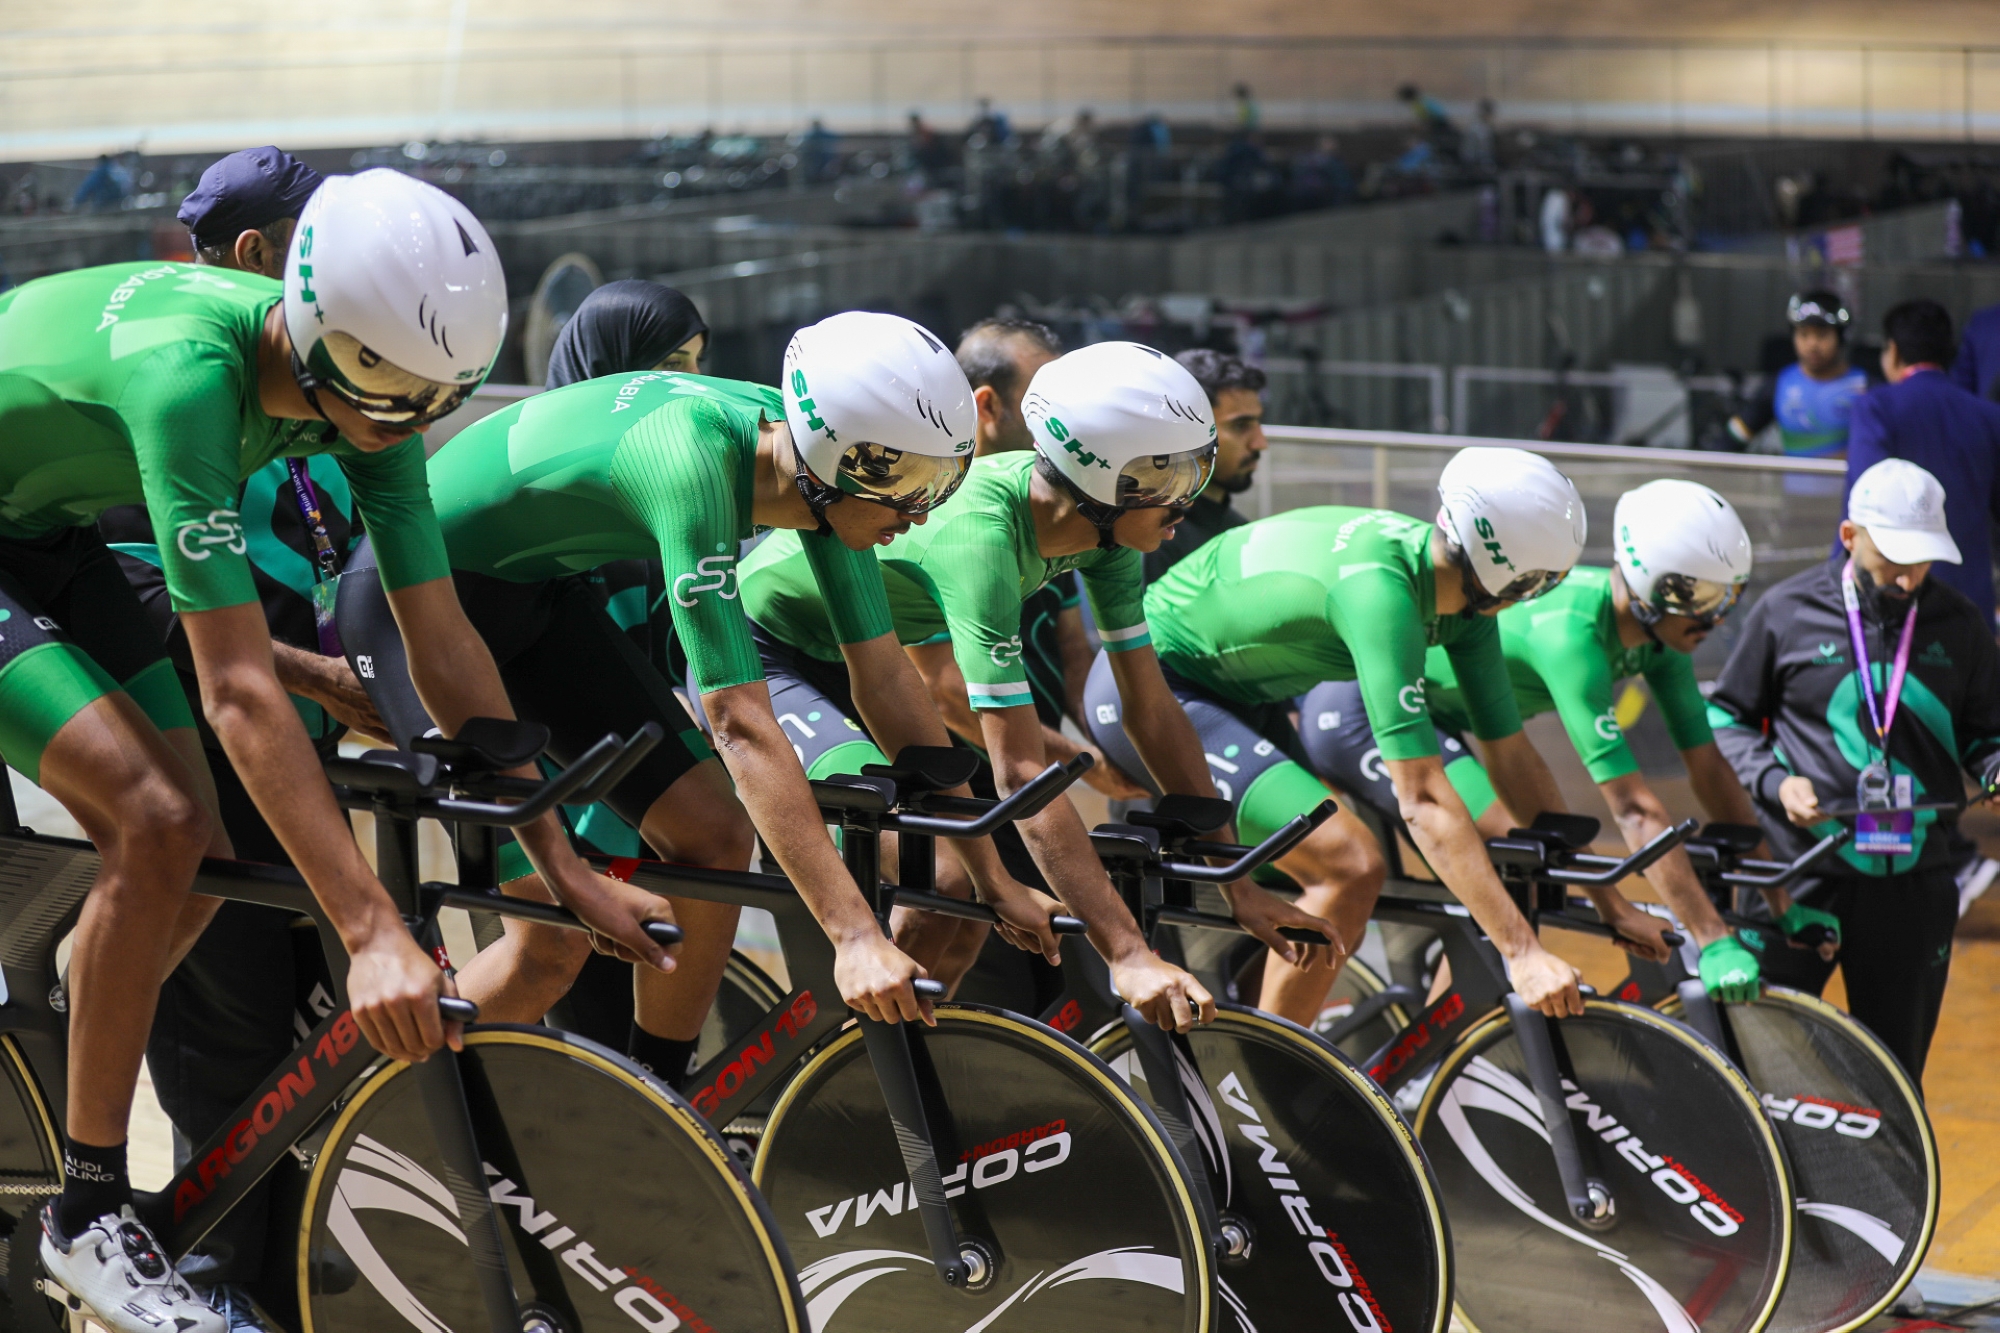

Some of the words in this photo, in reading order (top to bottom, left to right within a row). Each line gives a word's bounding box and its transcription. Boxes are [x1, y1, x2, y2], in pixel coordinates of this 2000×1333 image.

[95, 264, 177, 333] ARABIA
[775, 990, 817, 1040] 18
[1429, 993, 1465, 1030] 18
[174, 1055, 316, 1226] ARGON
[314, 1010, 361, 1068] 18
[959, 1119, 1066, 1162] CARBON+
[65, 1149, 102, 1173] AUDI
[65, 1162, 115, 1182] CLING
[1560, 1079, 1740, 1237] CORIM
[1662, 1154, 1746, 1224] CARBON+
[483, 1161, 681, 1333] ORIM
